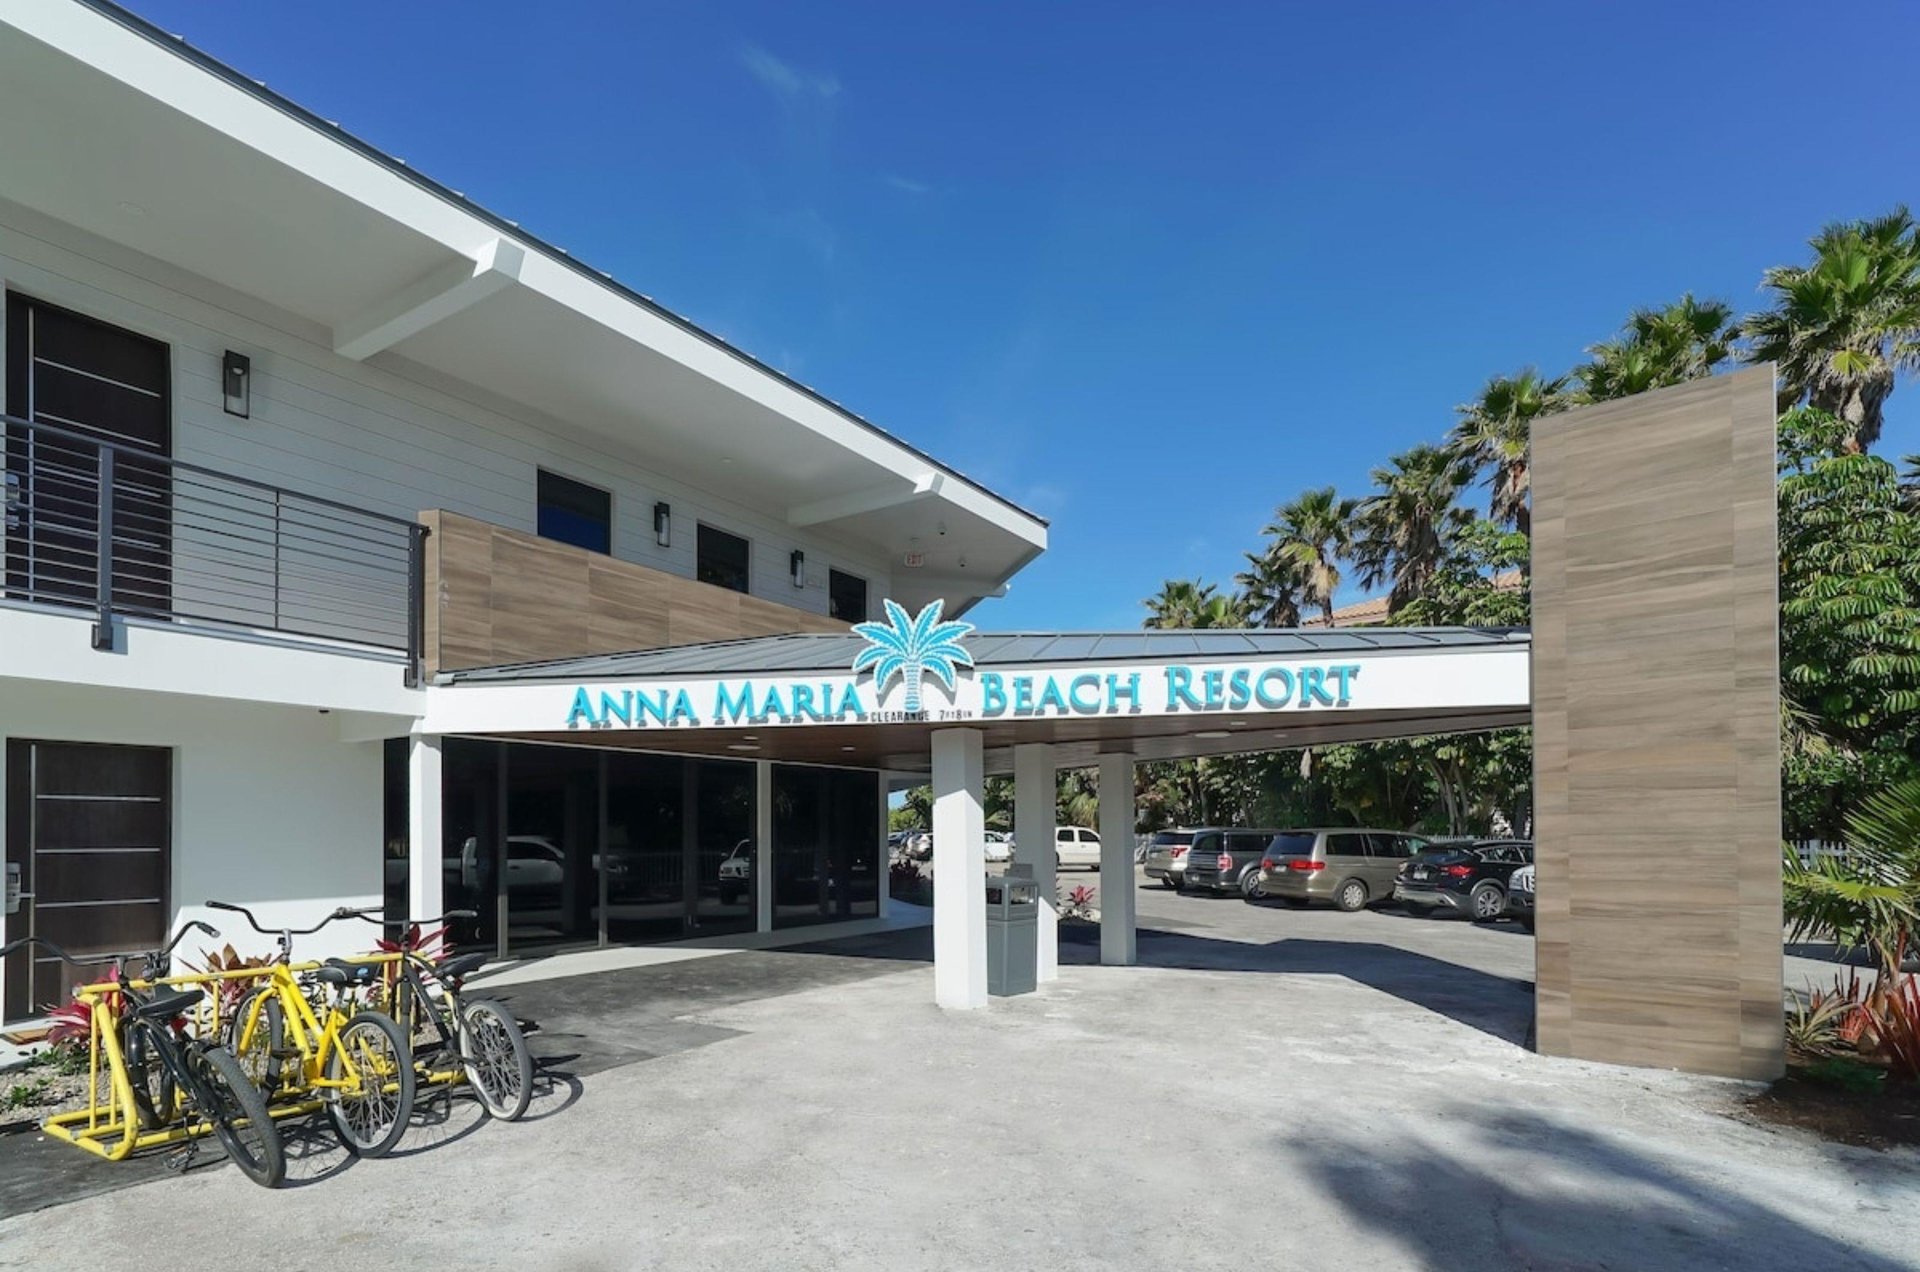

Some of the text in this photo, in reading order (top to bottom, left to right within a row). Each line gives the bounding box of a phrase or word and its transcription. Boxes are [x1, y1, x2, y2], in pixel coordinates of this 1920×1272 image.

[567, 664, 1360, 727] ANNA MARIA BEACH RESORT
